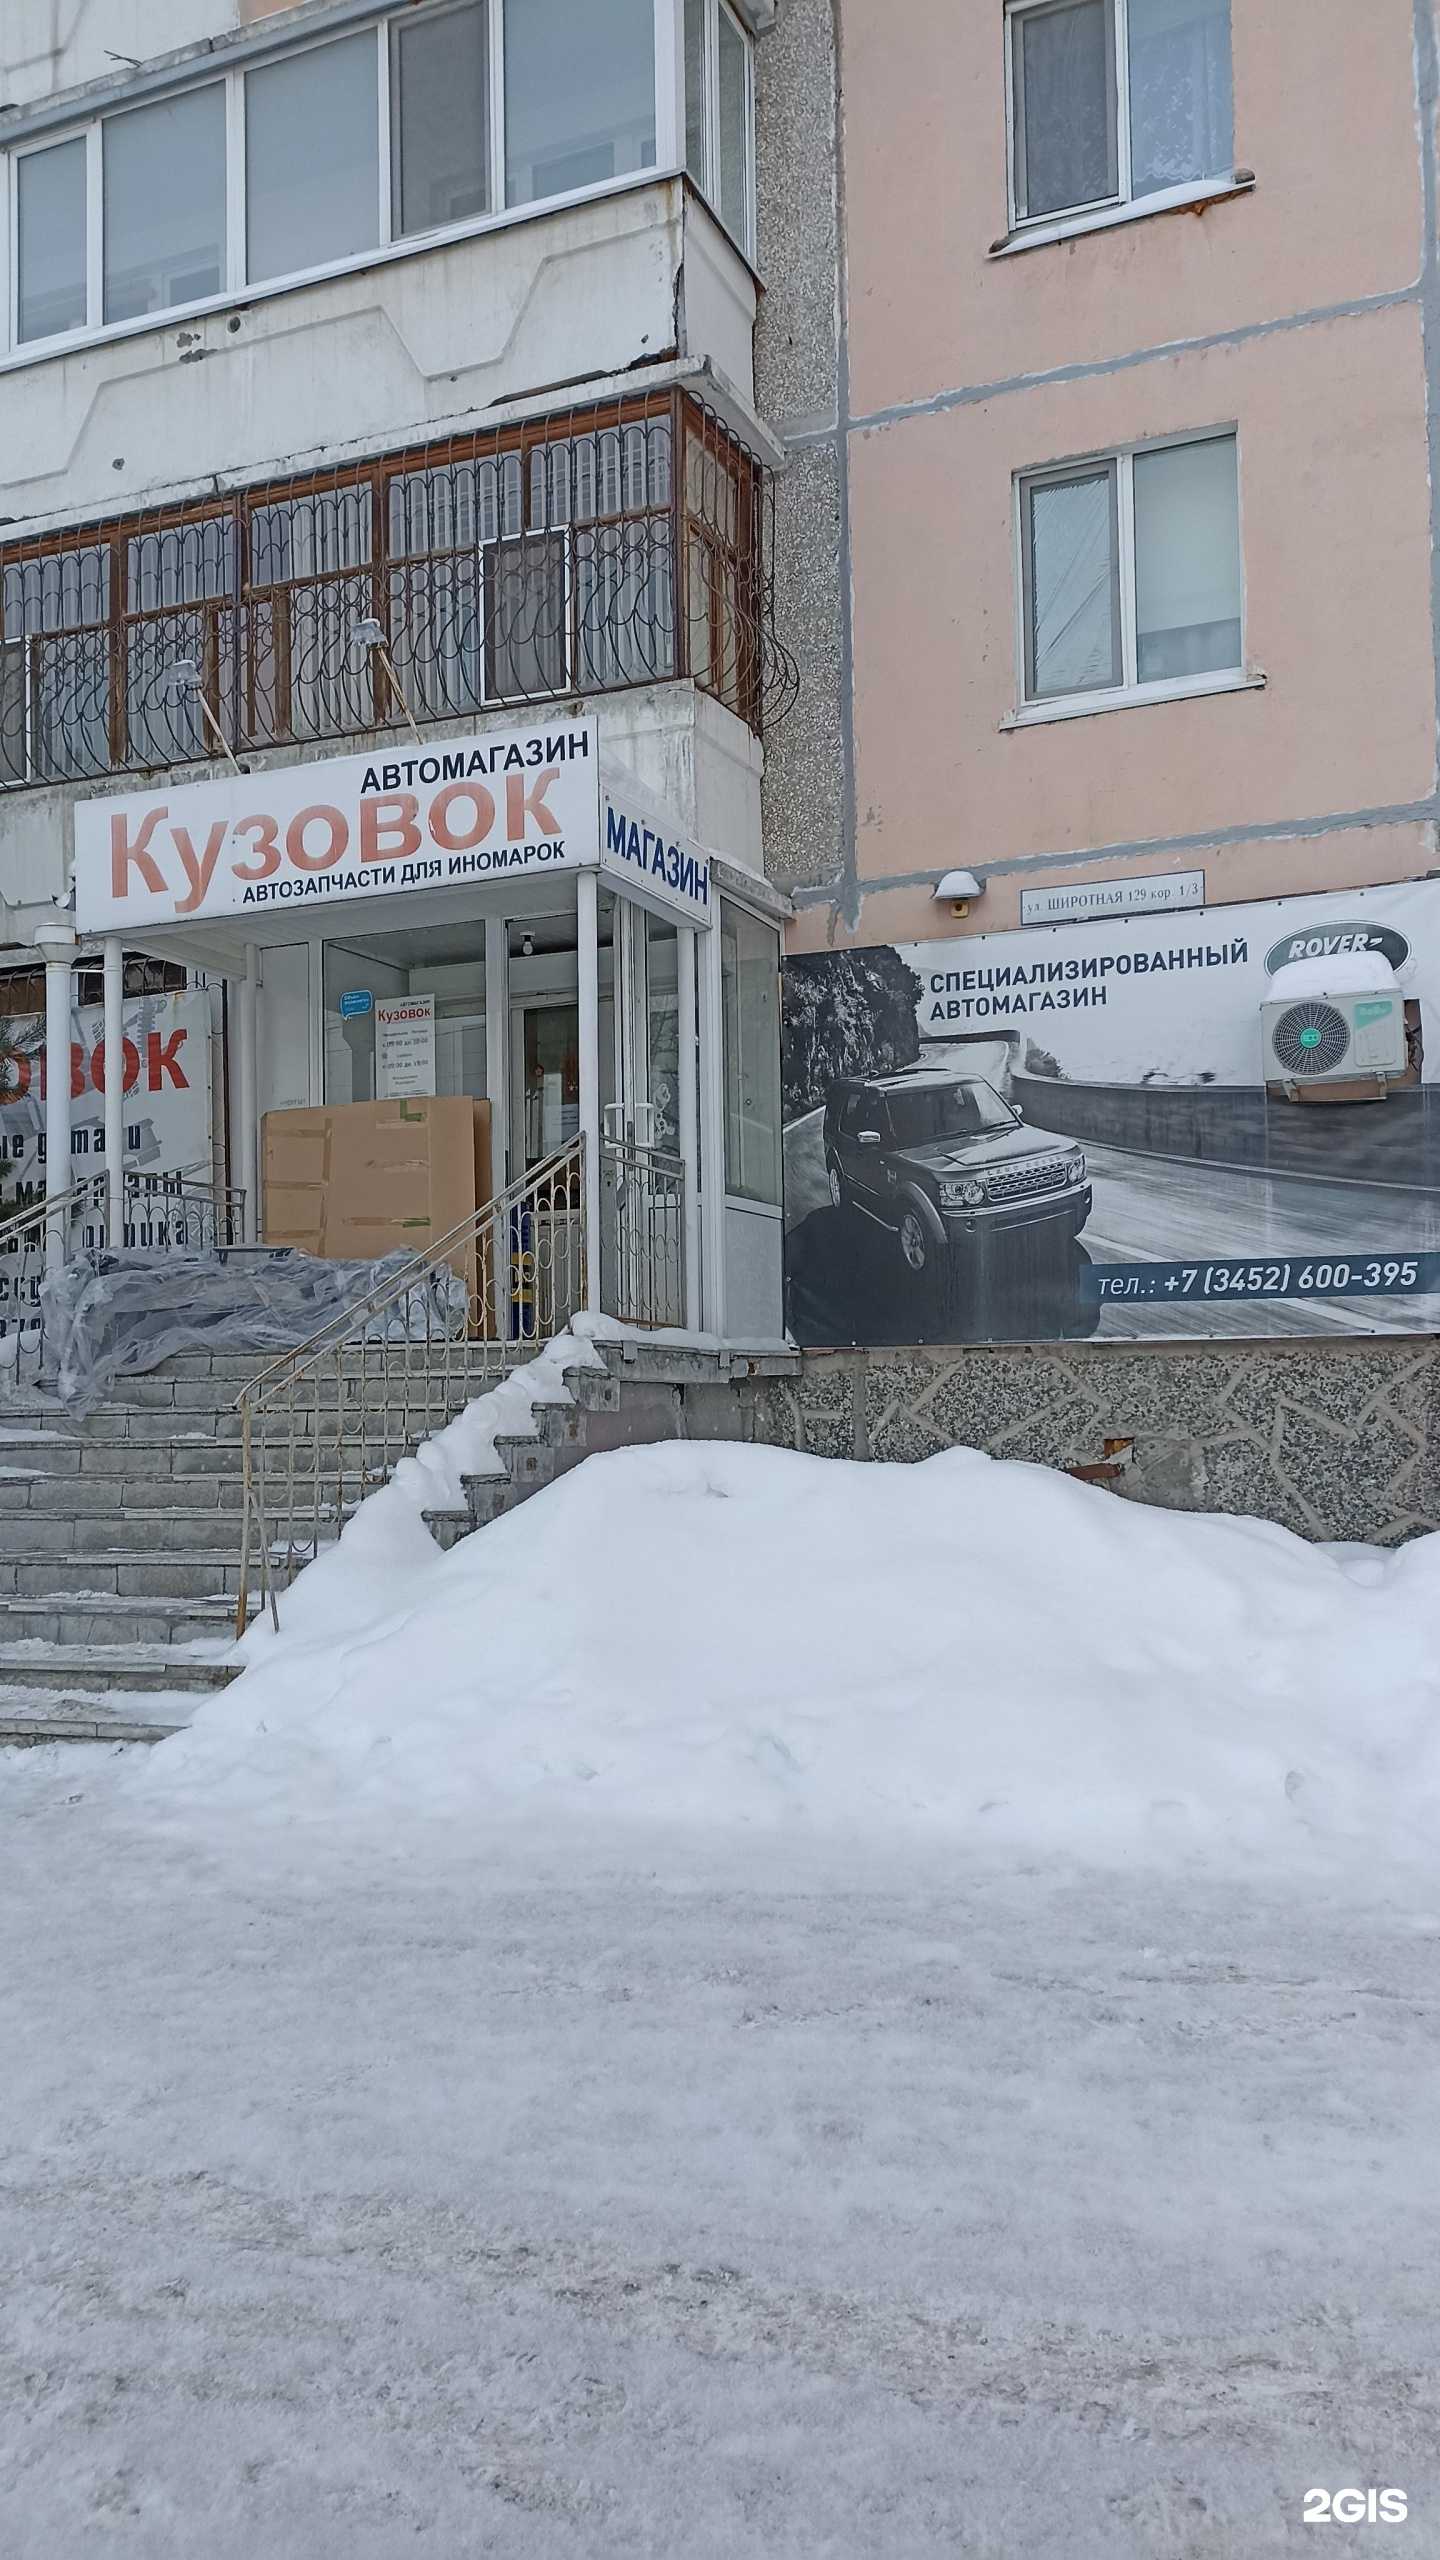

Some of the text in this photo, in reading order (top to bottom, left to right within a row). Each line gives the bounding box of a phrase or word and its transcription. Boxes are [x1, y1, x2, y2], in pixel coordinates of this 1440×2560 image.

[360, 730, 588, 794] АВТОМАГАЗИН
[242, 840, 565, 903] АВТОЗАПЧАСТИ ДЛЯ ИНОМАРОК
[607, 806, 708, 905] МАГАЗИН
[1048, 890, 1123, 910] ШИРОТНАЯ
[1128, 888, 1147, 902] 129
[1179, 882, 1199, 897] 1/3
[930, 937, 1248, 994] СПЕЦИАЛИЗИРОВАННЫЙ
[929, 985, 1107, 1020] АВТОМАГАЗИН
[1099, 1261, 1419, 1295] тел.: +7 (3452) 600-395
